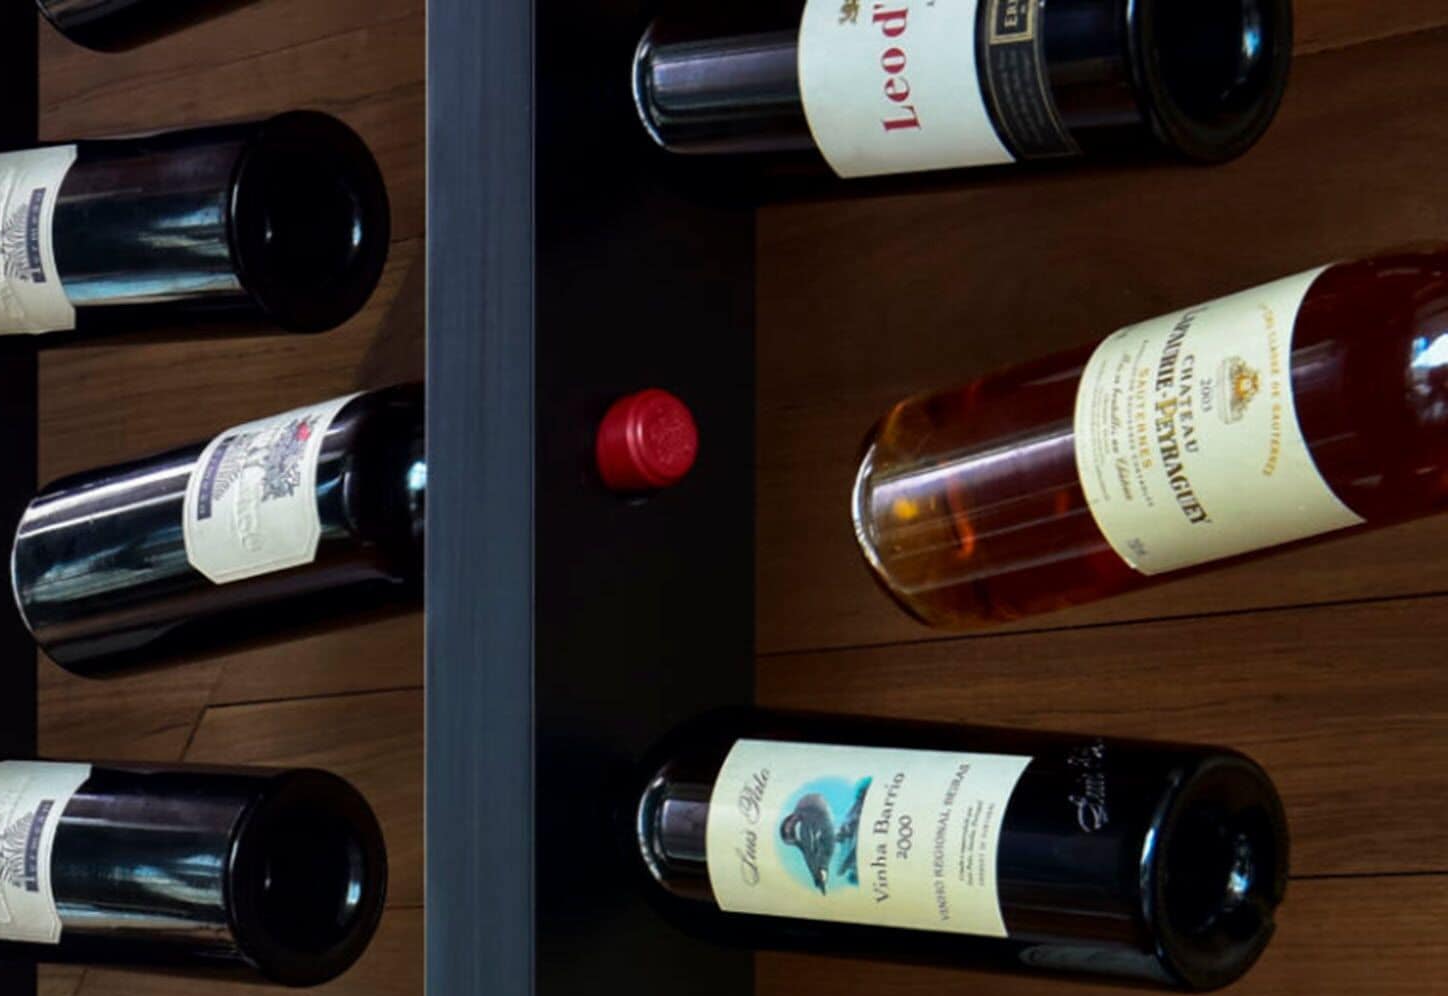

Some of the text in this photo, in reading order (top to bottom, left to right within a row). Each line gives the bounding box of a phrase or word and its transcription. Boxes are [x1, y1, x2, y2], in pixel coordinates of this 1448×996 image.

[882, 47, 921, 132] Leo
[1133, 368, 1155, 469] SAUTERNES
[870, 771, 907, 903] Vinha Barrio
[895, 814, 915, 859] 2000
[932, 762, 971, 920] VINHO REGIONAL BEIRAS
